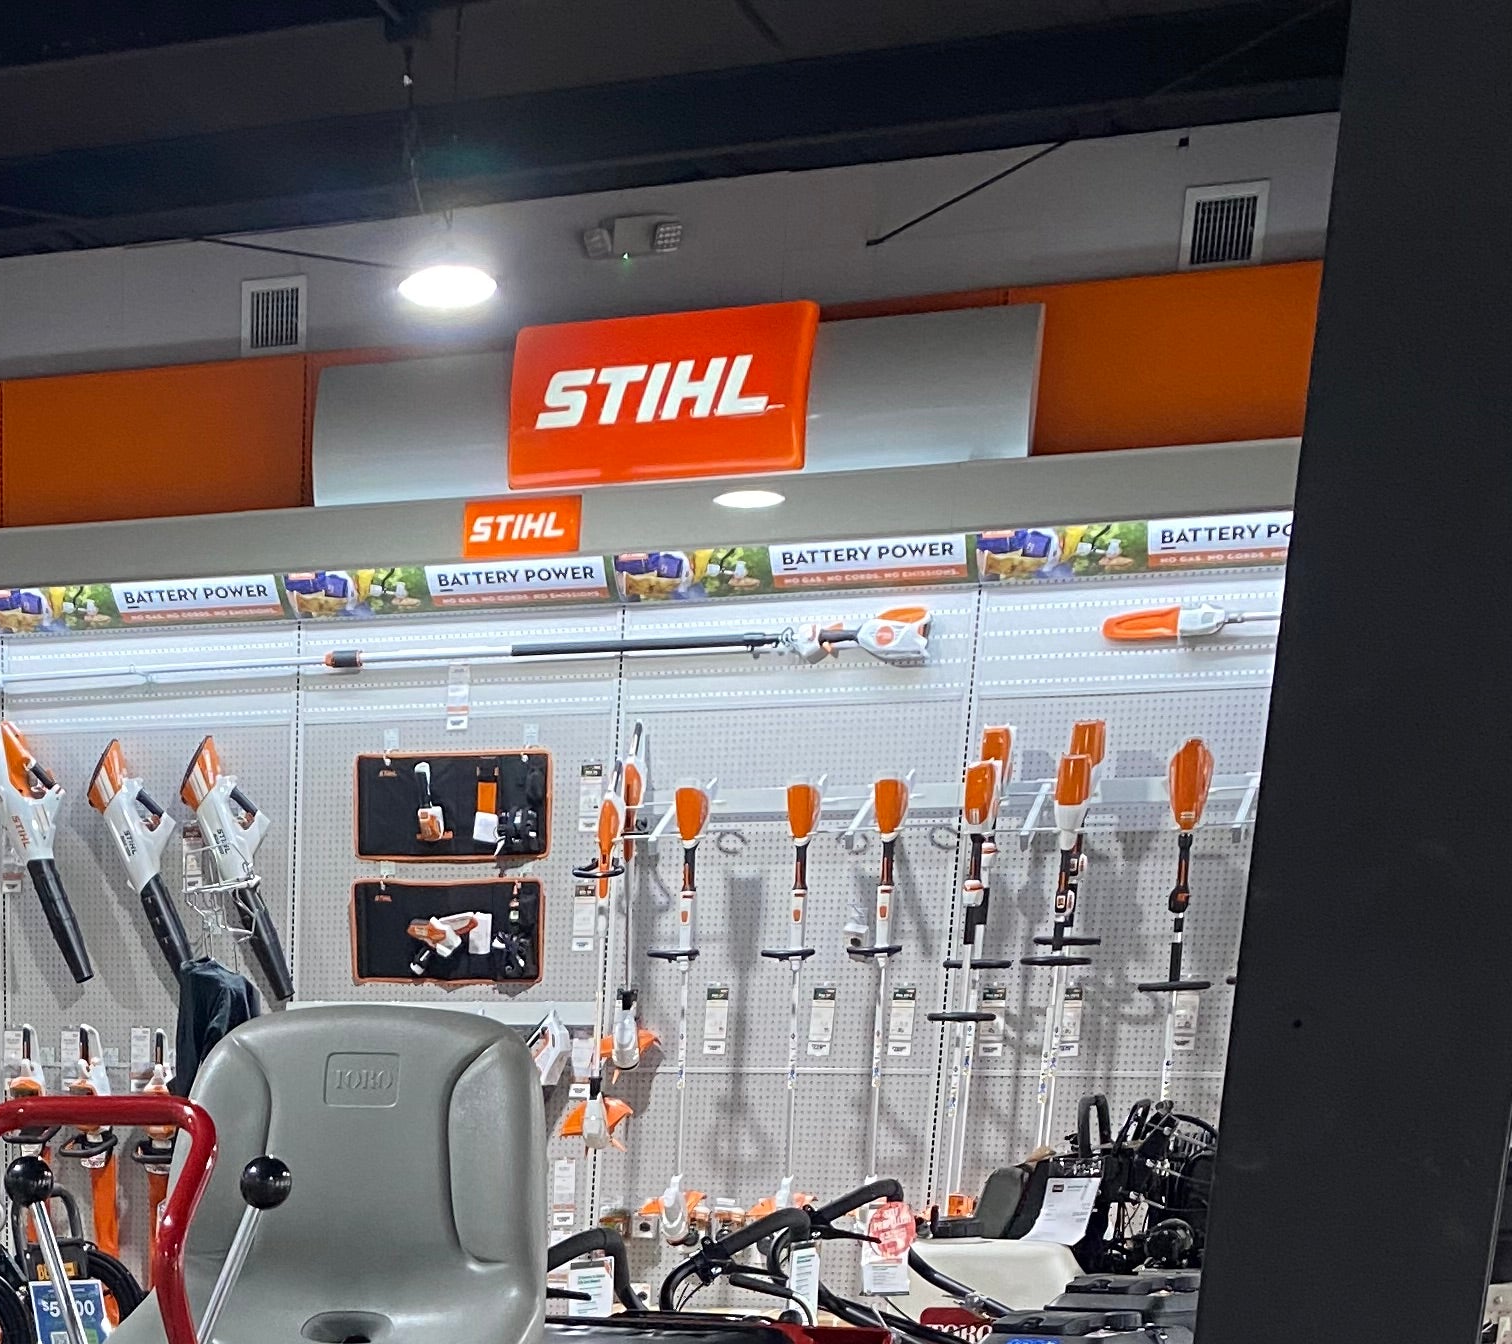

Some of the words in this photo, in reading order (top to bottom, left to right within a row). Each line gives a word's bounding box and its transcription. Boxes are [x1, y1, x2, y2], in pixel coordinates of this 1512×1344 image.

[535, 355, 769, 430] STIHL
[469, 512, 565, 543] STIHL
[1161, 523, 1261, 544] BATTERY
[782, 547, 872, 566] BATTERY
[877, 542, 954, 559] POWER
[437, 569, 519, 587] BATTERY
[525, 566, 595, 582] POWER
[123, 587, 198, 604] BATTERY
[203, 584, 268, 599] POWER
[11, 815, 30, 849] STIHL
[334, 1069, 394, 1089] TORO
